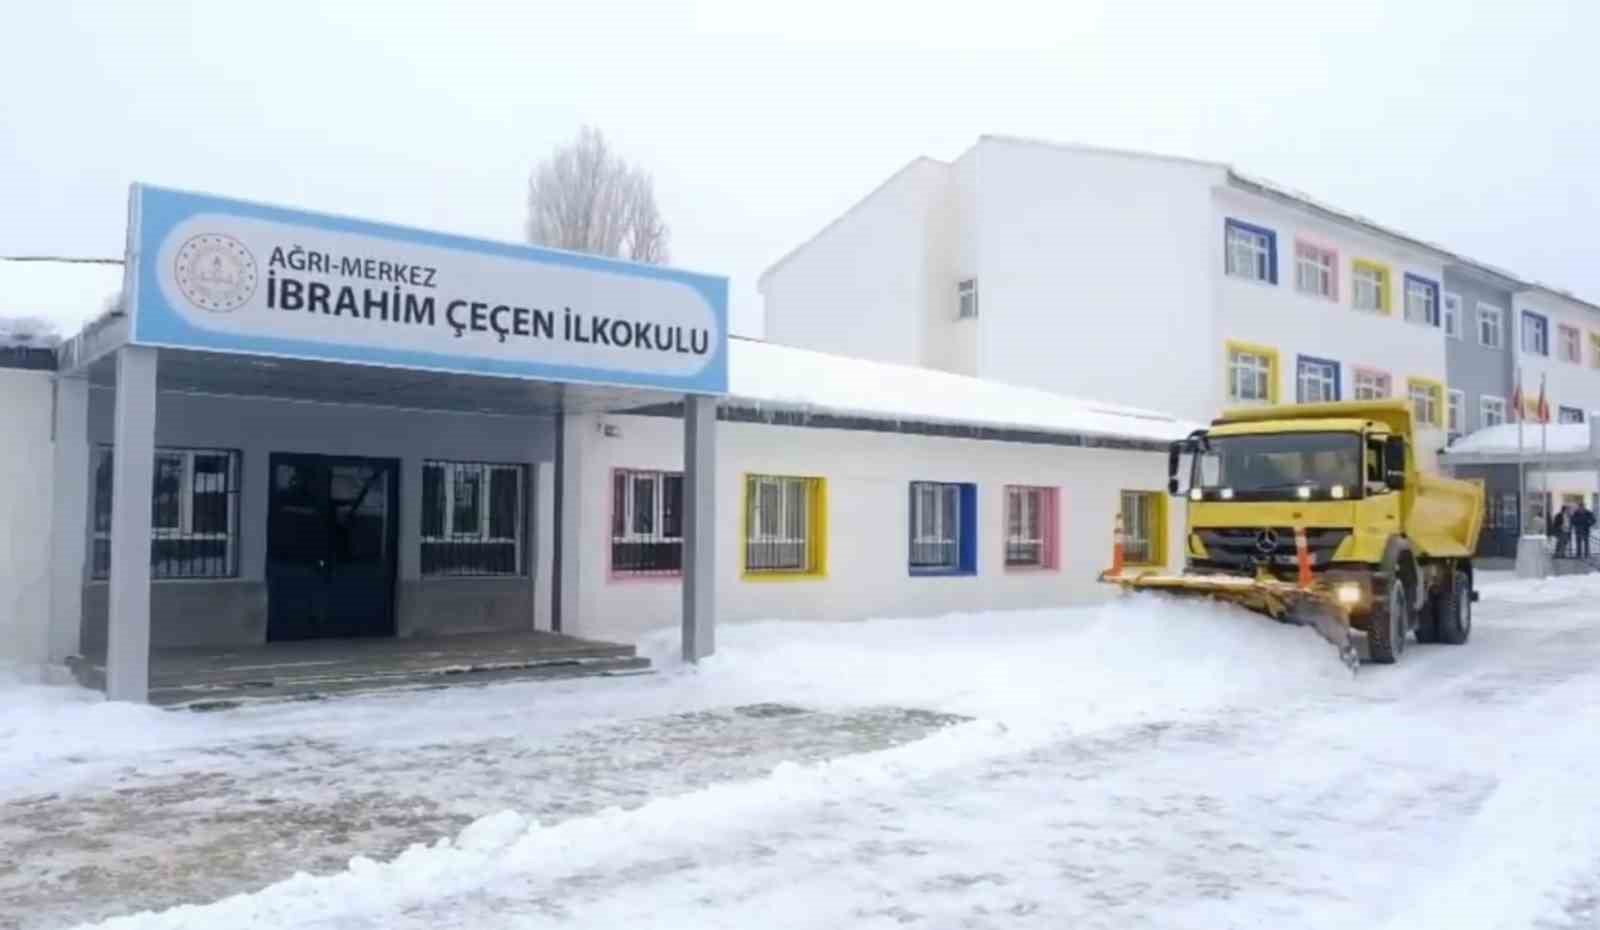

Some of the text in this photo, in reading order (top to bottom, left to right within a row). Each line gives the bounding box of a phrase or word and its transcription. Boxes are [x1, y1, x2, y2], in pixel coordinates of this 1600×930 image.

[269, 244, 437, 288] AĞRI-MERKEZ
[267, 269, 709, 355] İBRAHİM ÇEÇEN İLKOKULU
